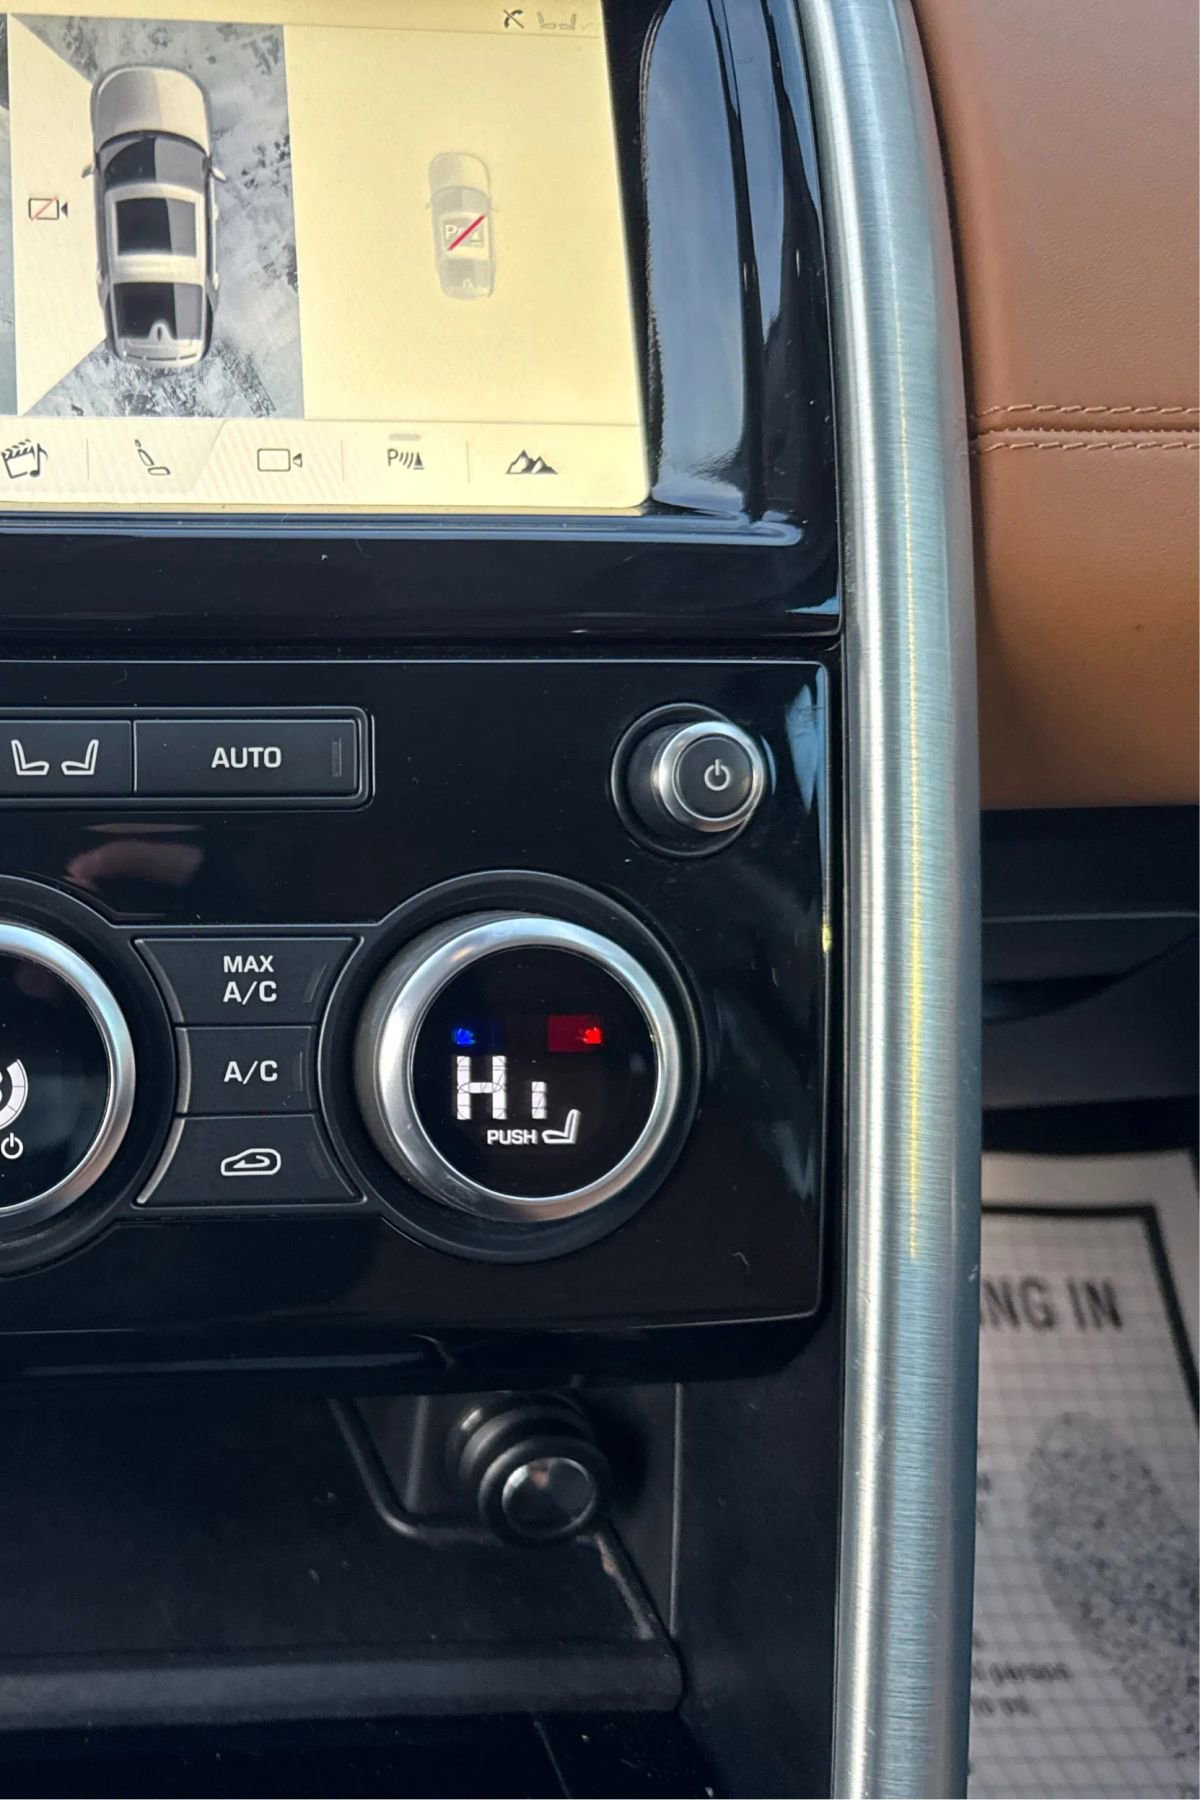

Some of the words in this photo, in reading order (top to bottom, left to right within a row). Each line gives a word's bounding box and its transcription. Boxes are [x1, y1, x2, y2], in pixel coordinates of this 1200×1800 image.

[211, 746, 282, 769] AUTO
[223, 955, 274, 973] MAX
[222, 980, 277, 1005] A/C
[223, 1060, 278, 1085] A/C
[486, 1129, 538, 1145] PUSH
[1066, 1278, 1122, 1331] IN
